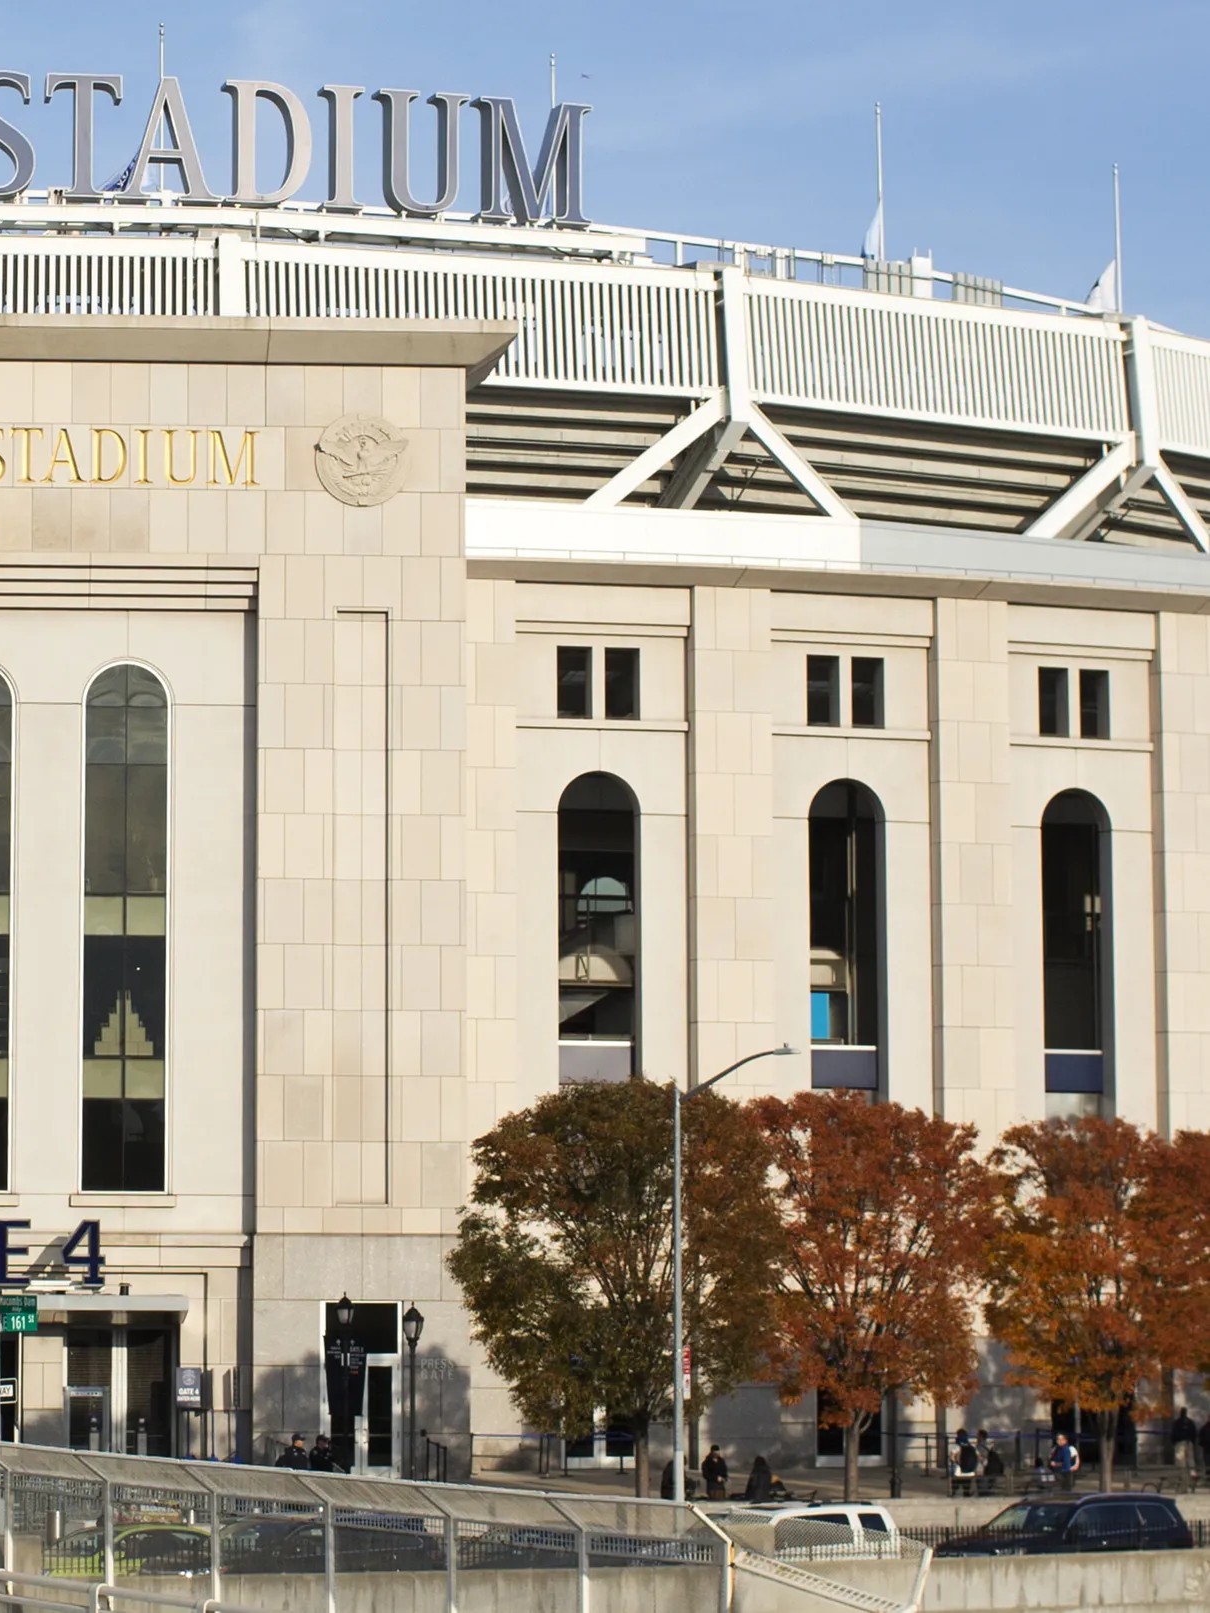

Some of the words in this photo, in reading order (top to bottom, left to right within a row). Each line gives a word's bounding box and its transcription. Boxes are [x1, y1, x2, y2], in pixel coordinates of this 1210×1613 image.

[60, 1219, 106, 1287] 4
[10, 1315, 26, 1331] 161
[420, 1359, 454, 1369] PRESS
[420, 1369, 455, 1380] GATE
[178, 1387, 194, 1396] GATE
